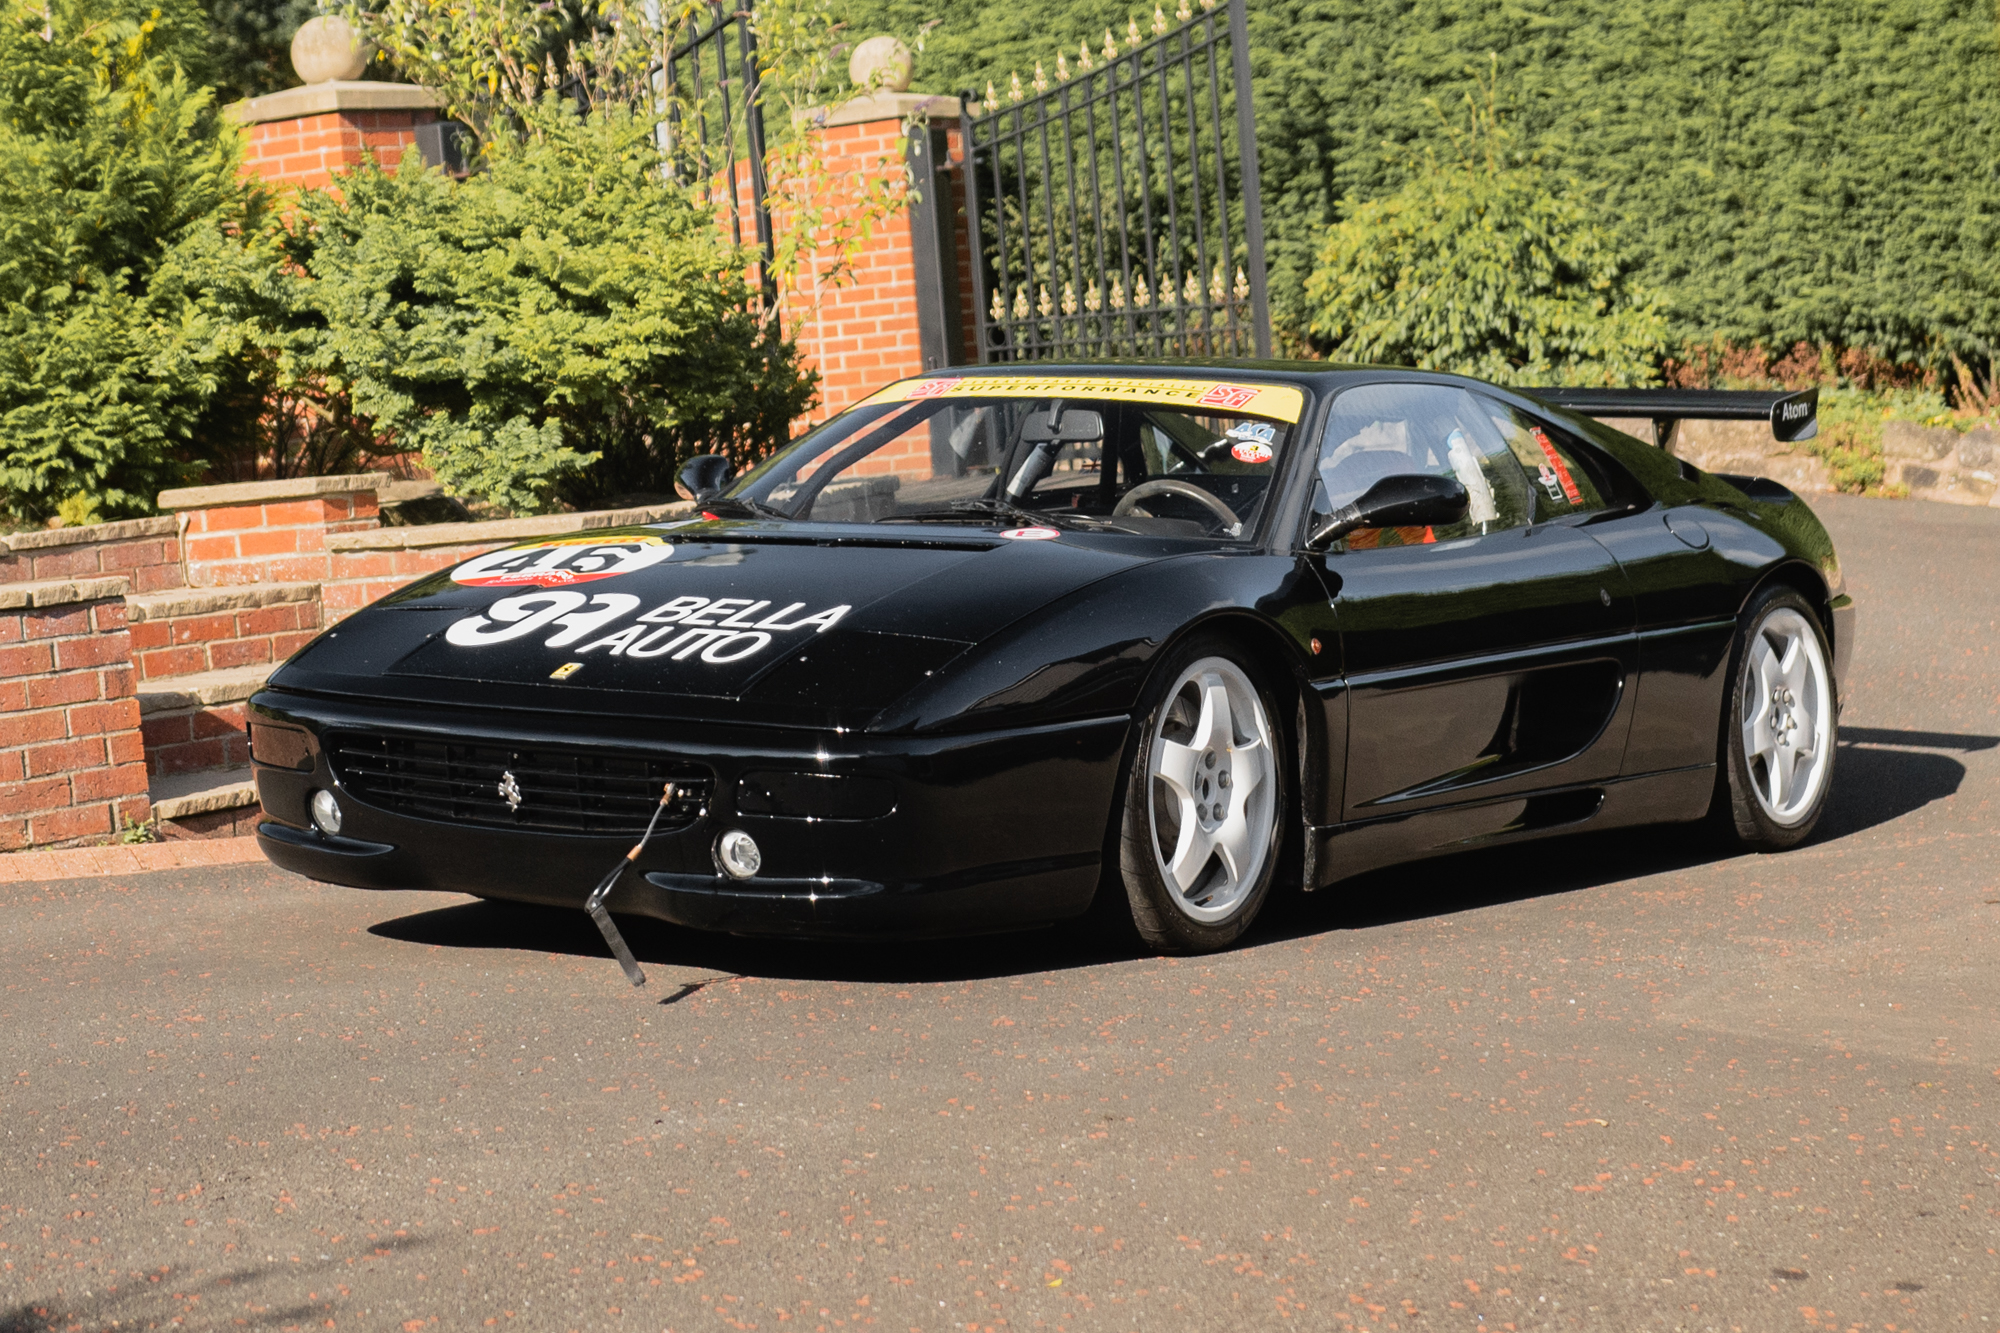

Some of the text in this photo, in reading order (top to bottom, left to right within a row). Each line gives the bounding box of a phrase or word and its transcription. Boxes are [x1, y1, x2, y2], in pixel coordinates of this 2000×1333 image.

[951, 385, 1200, 398] SUPERFORMANCE
[1782, 402, 1808, 421] Atom
[636, 595, 852, 633] BELLA
[574, 624, 772, 664] AUTO
